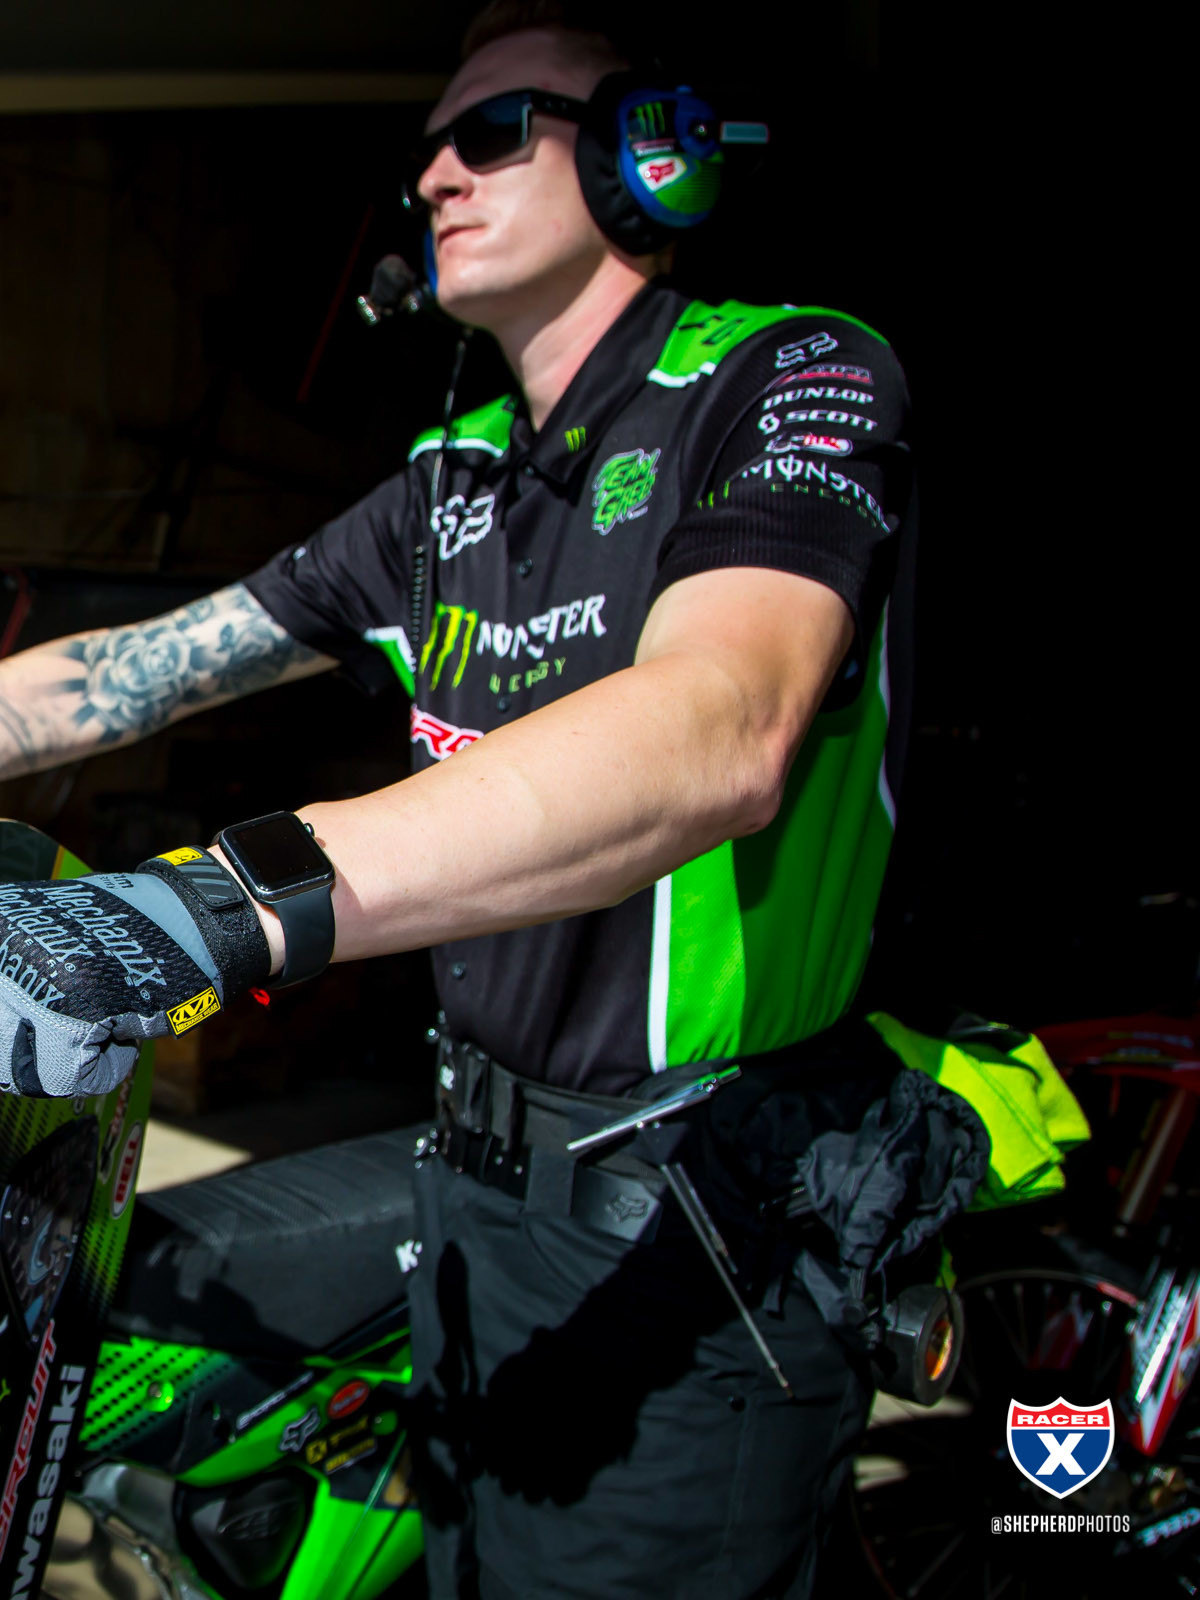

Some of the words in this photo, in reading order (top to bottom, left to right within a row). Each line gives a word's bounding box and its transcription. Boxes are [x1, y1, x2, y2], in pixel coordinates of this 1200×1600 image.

[762, 386, 874, 411] DUNLOP
[784, 409, 878, 432] SCOTT
[7, 1362, 87, 1600] wasaki
